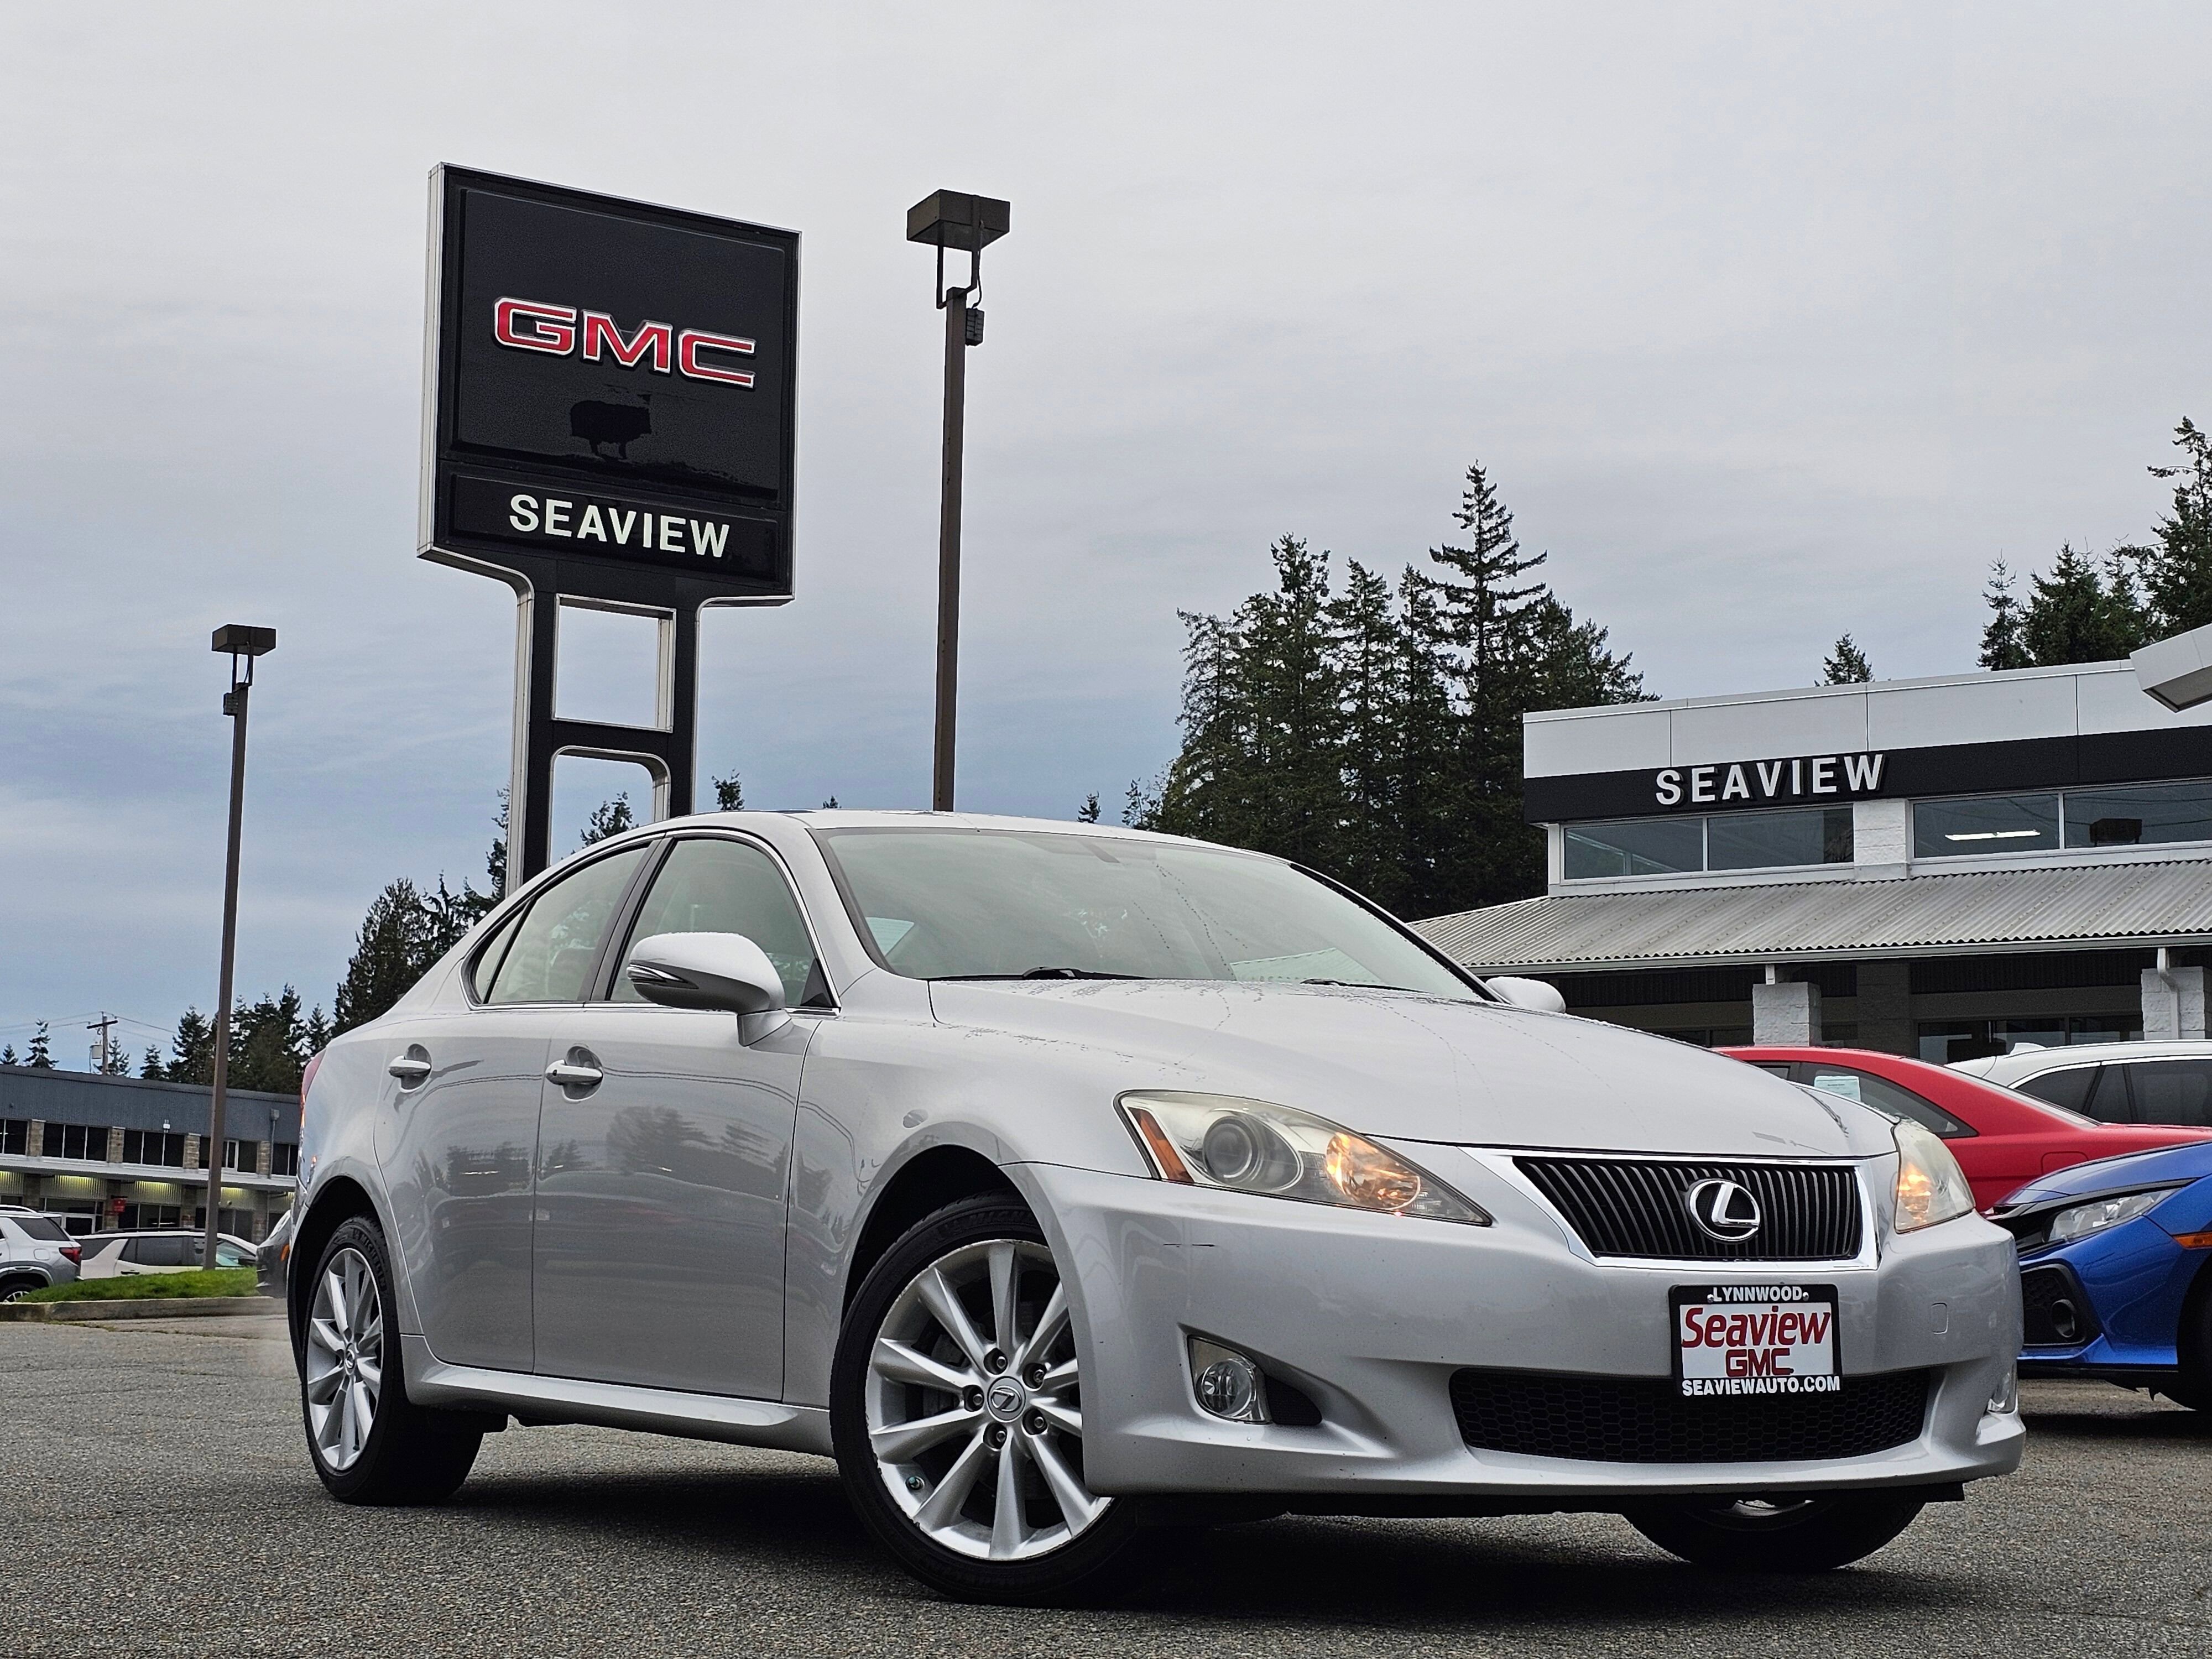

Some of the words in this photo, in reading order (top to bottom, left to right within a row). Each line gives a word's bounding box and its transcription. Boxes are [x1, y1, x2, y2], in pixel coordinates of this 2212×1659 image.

[494, 297, 756, 388] GMC
[509, 494, 730, 558] SEAVIEW
[1656, 754, 1883, 805] SEAVIEW
[1713, 1286, 1802, 1302] LYNNWOOD
[1682, 1306, 1831, 1348] Seaview
[1725, 1348, 1794, 1377] GMC
[1682, 1376, 1840, 1396] SEAVIEWAUTO.COM
